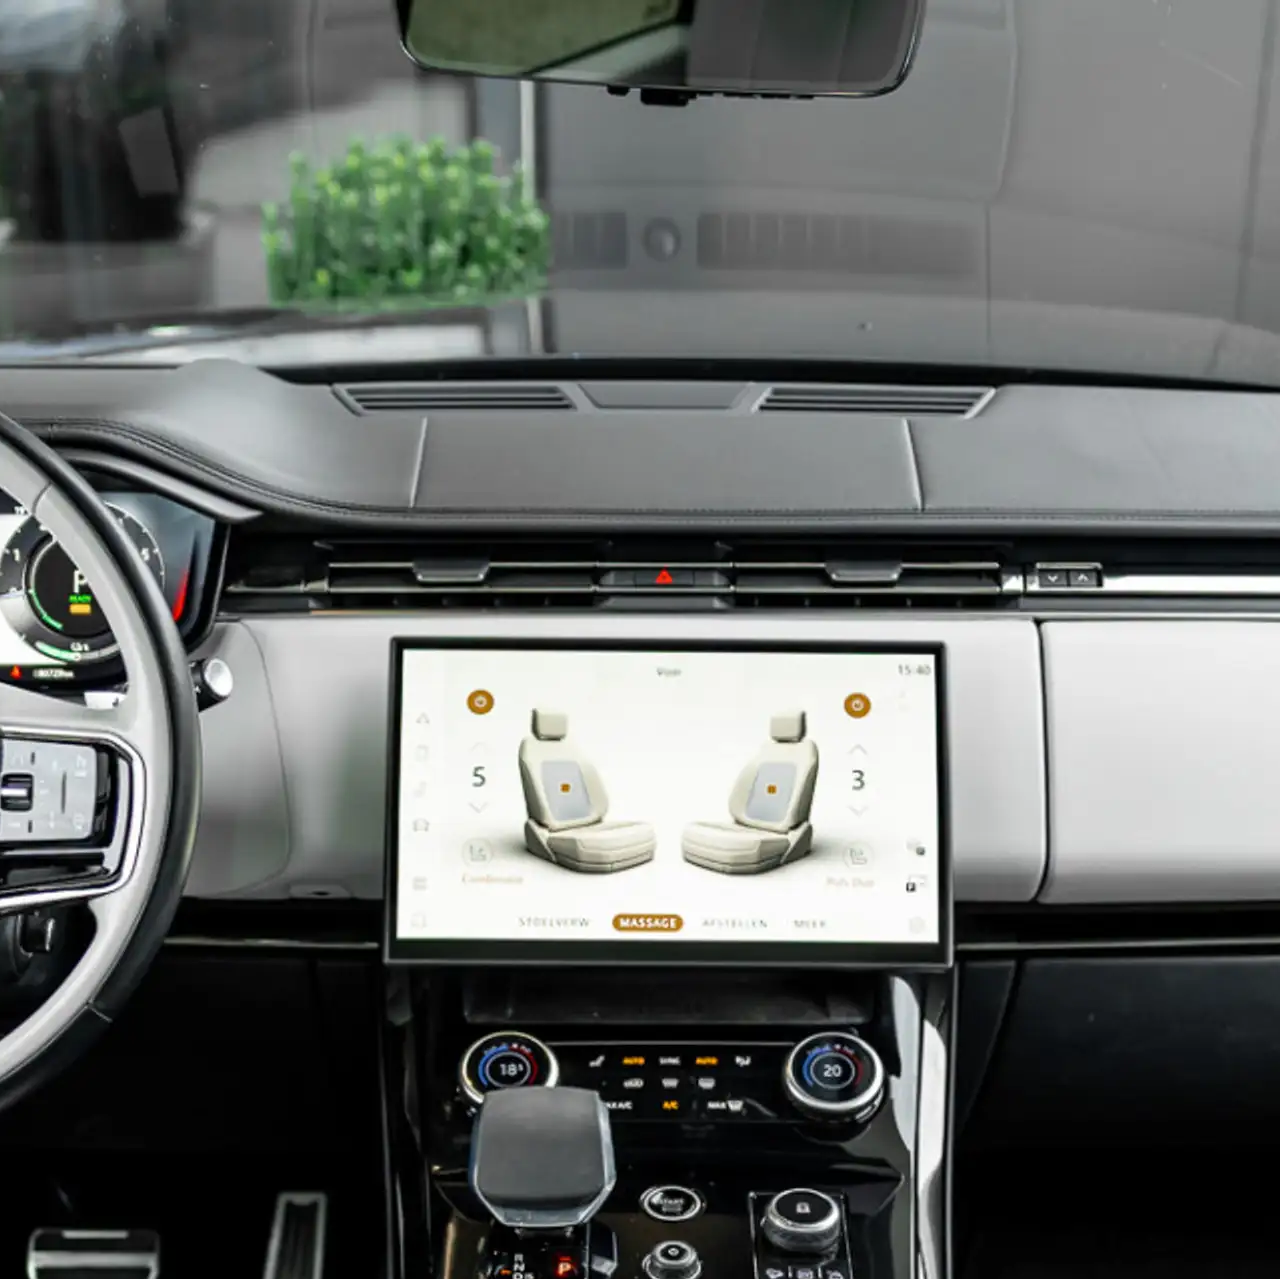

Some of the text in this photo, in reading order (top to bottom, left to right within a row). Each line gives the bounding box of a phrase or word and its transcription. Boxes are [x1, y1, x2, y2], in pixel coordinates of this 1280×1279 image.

[898, 664, 932, 676] 15:40
[472, 767, 487, 788] 5
[851, 769, 866, 791] 3
[619, 916, 678, 930] MASSAGE
[622, 1056, 645, 1066] AUTO
[695, 1056, 718, 1066] AUTO
[823, 1064, 842, 1078] 20
[662, 1101, 680, 1110] A/C
[558, 1261, 573, 1277] P
